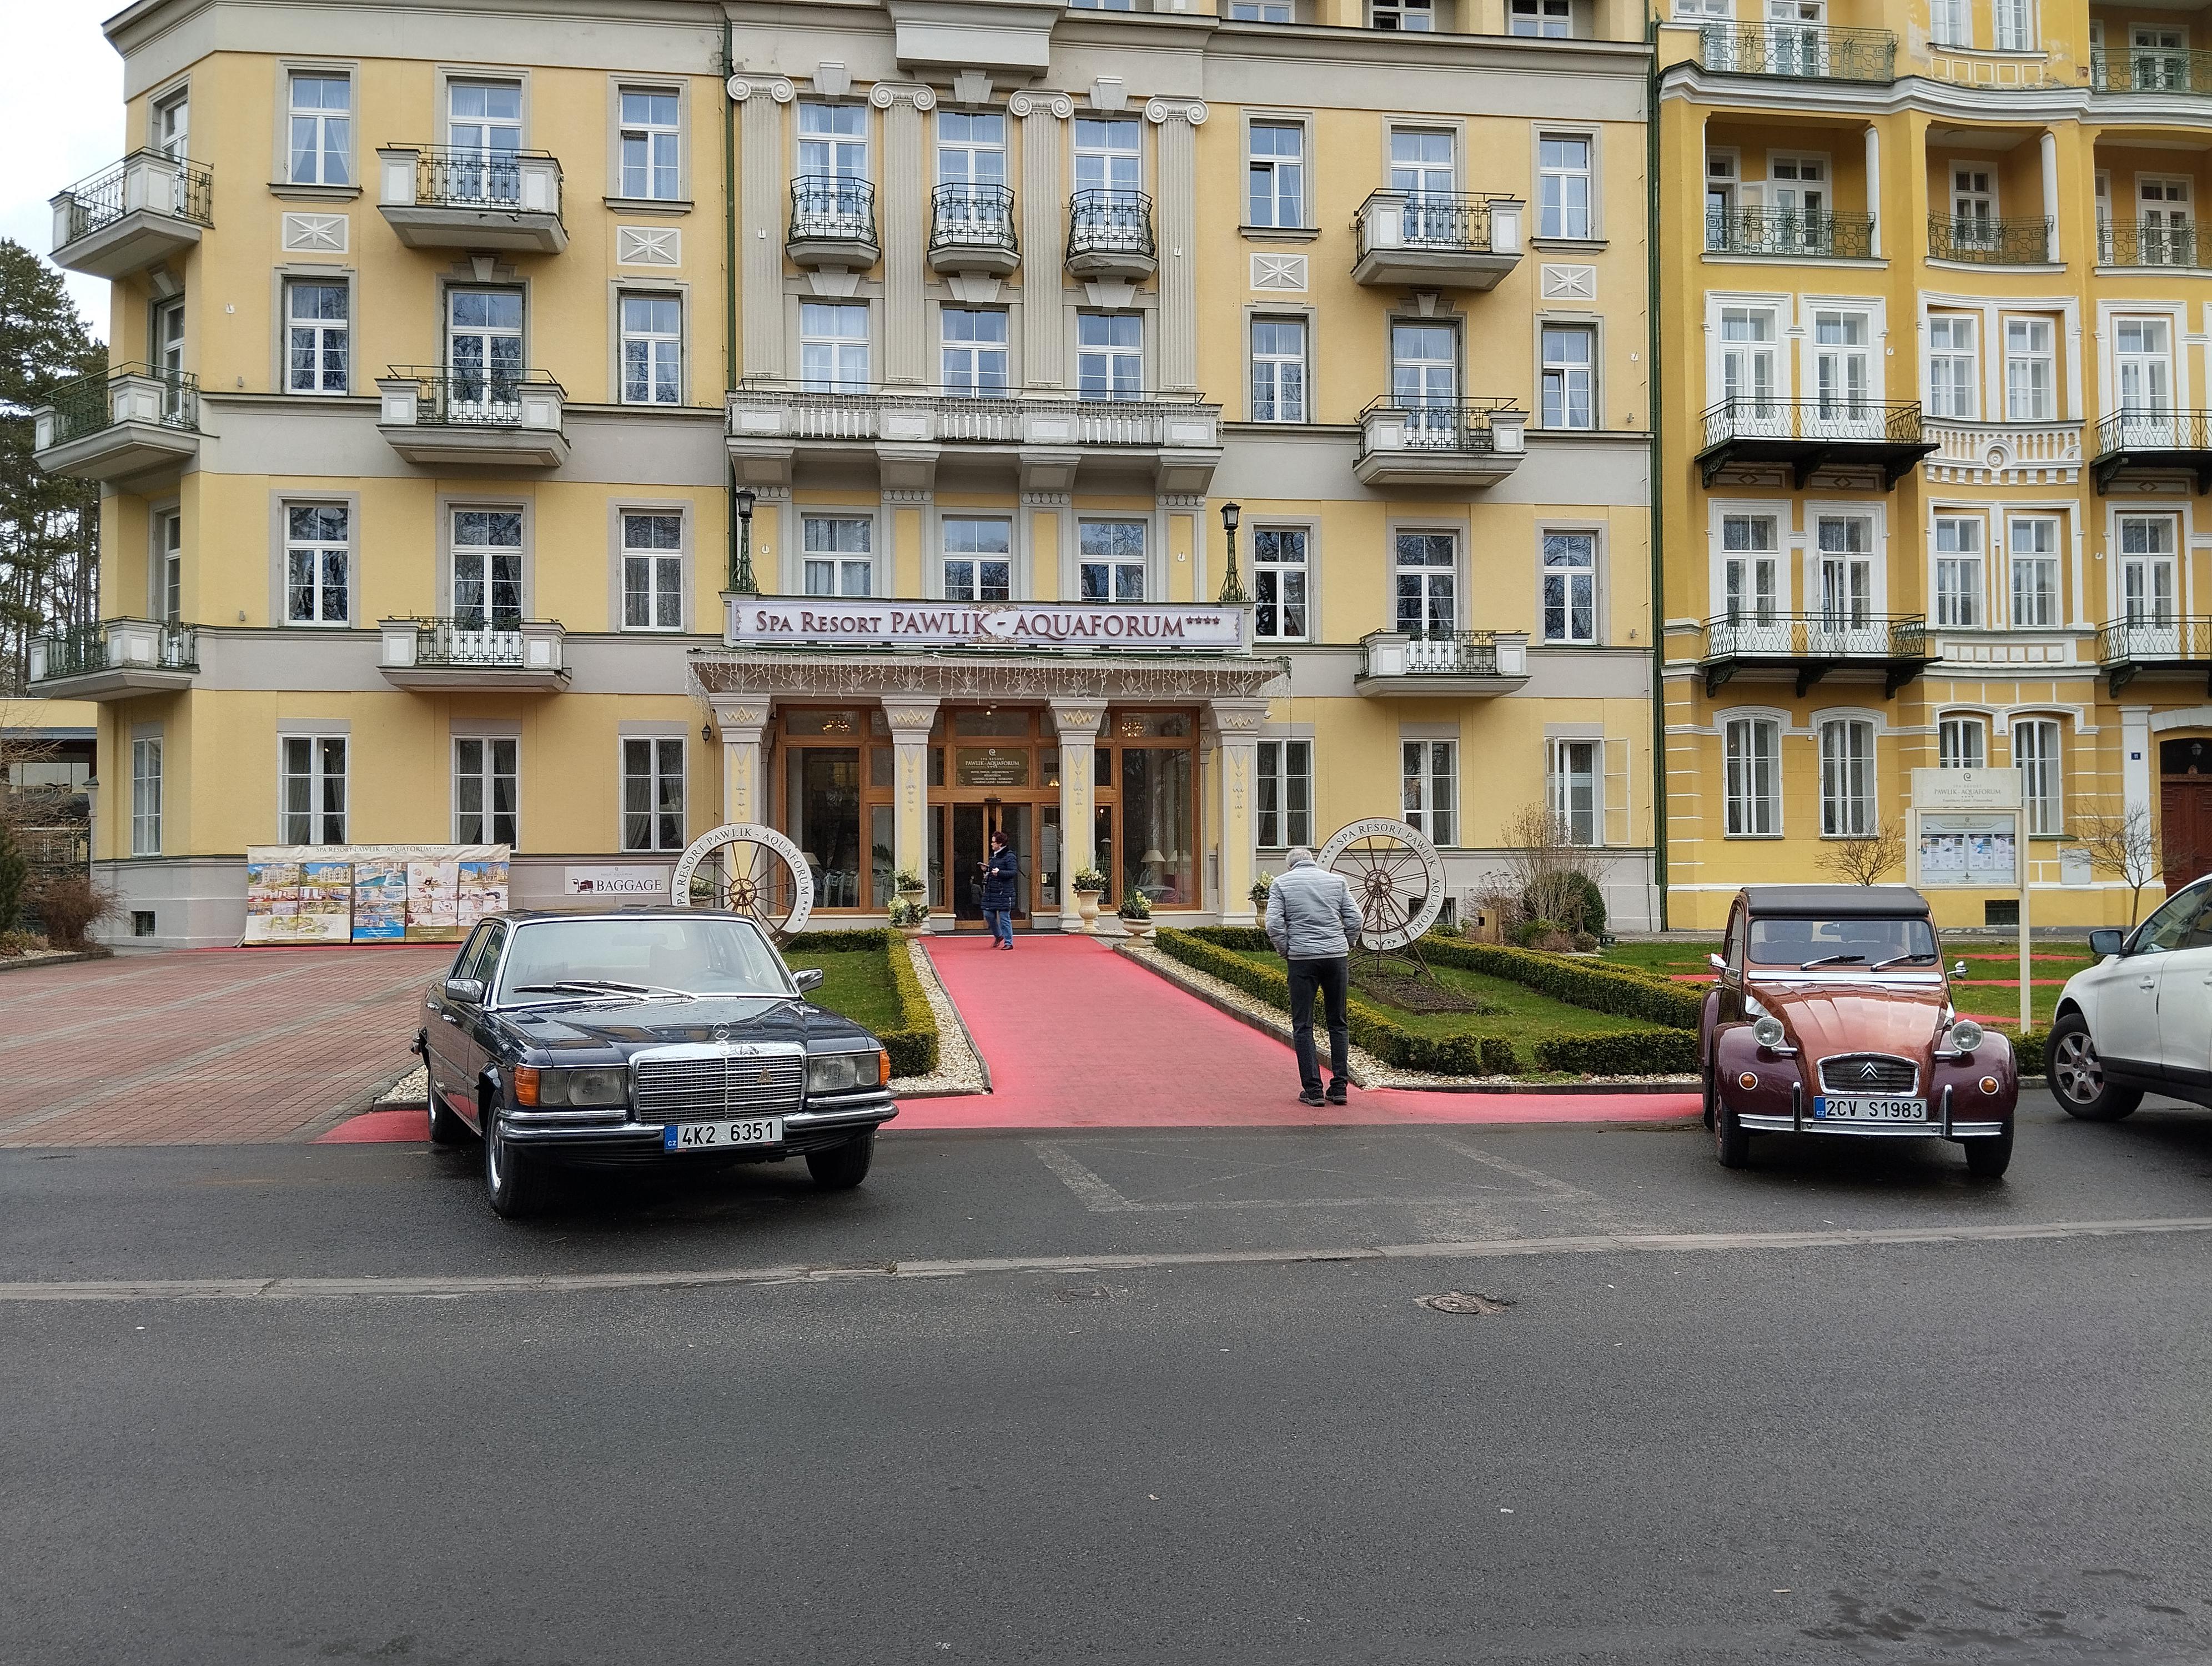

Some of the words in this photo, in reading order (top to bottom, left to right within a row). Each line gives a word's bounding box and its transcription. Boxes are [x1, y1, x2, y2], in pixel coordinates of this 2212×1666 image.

[891, 611, 992, 635] PAWLIK
[1012, 614, 1185, 641] AQUAFORUM
[1336, 830, 1356, 846] SPA
[1358, 823, 1404, 836] RESORT
[1405, 831, 1437, 869] PAWLIK
[677, 842, 705, 886] RESORT
[706, 828, 753, 845] PAWLIK
[761, 832, 809, 896] AQUAFORUM
[596, 879, 663, 892] BAGGAGE
[1826, 1100, 1857, 1117] 2CV
[1868, 1101, 1922, 1118] S1983
[682, 1125, 716, 1145] 4K2
[730, 1121, 773, 1142] 6351
